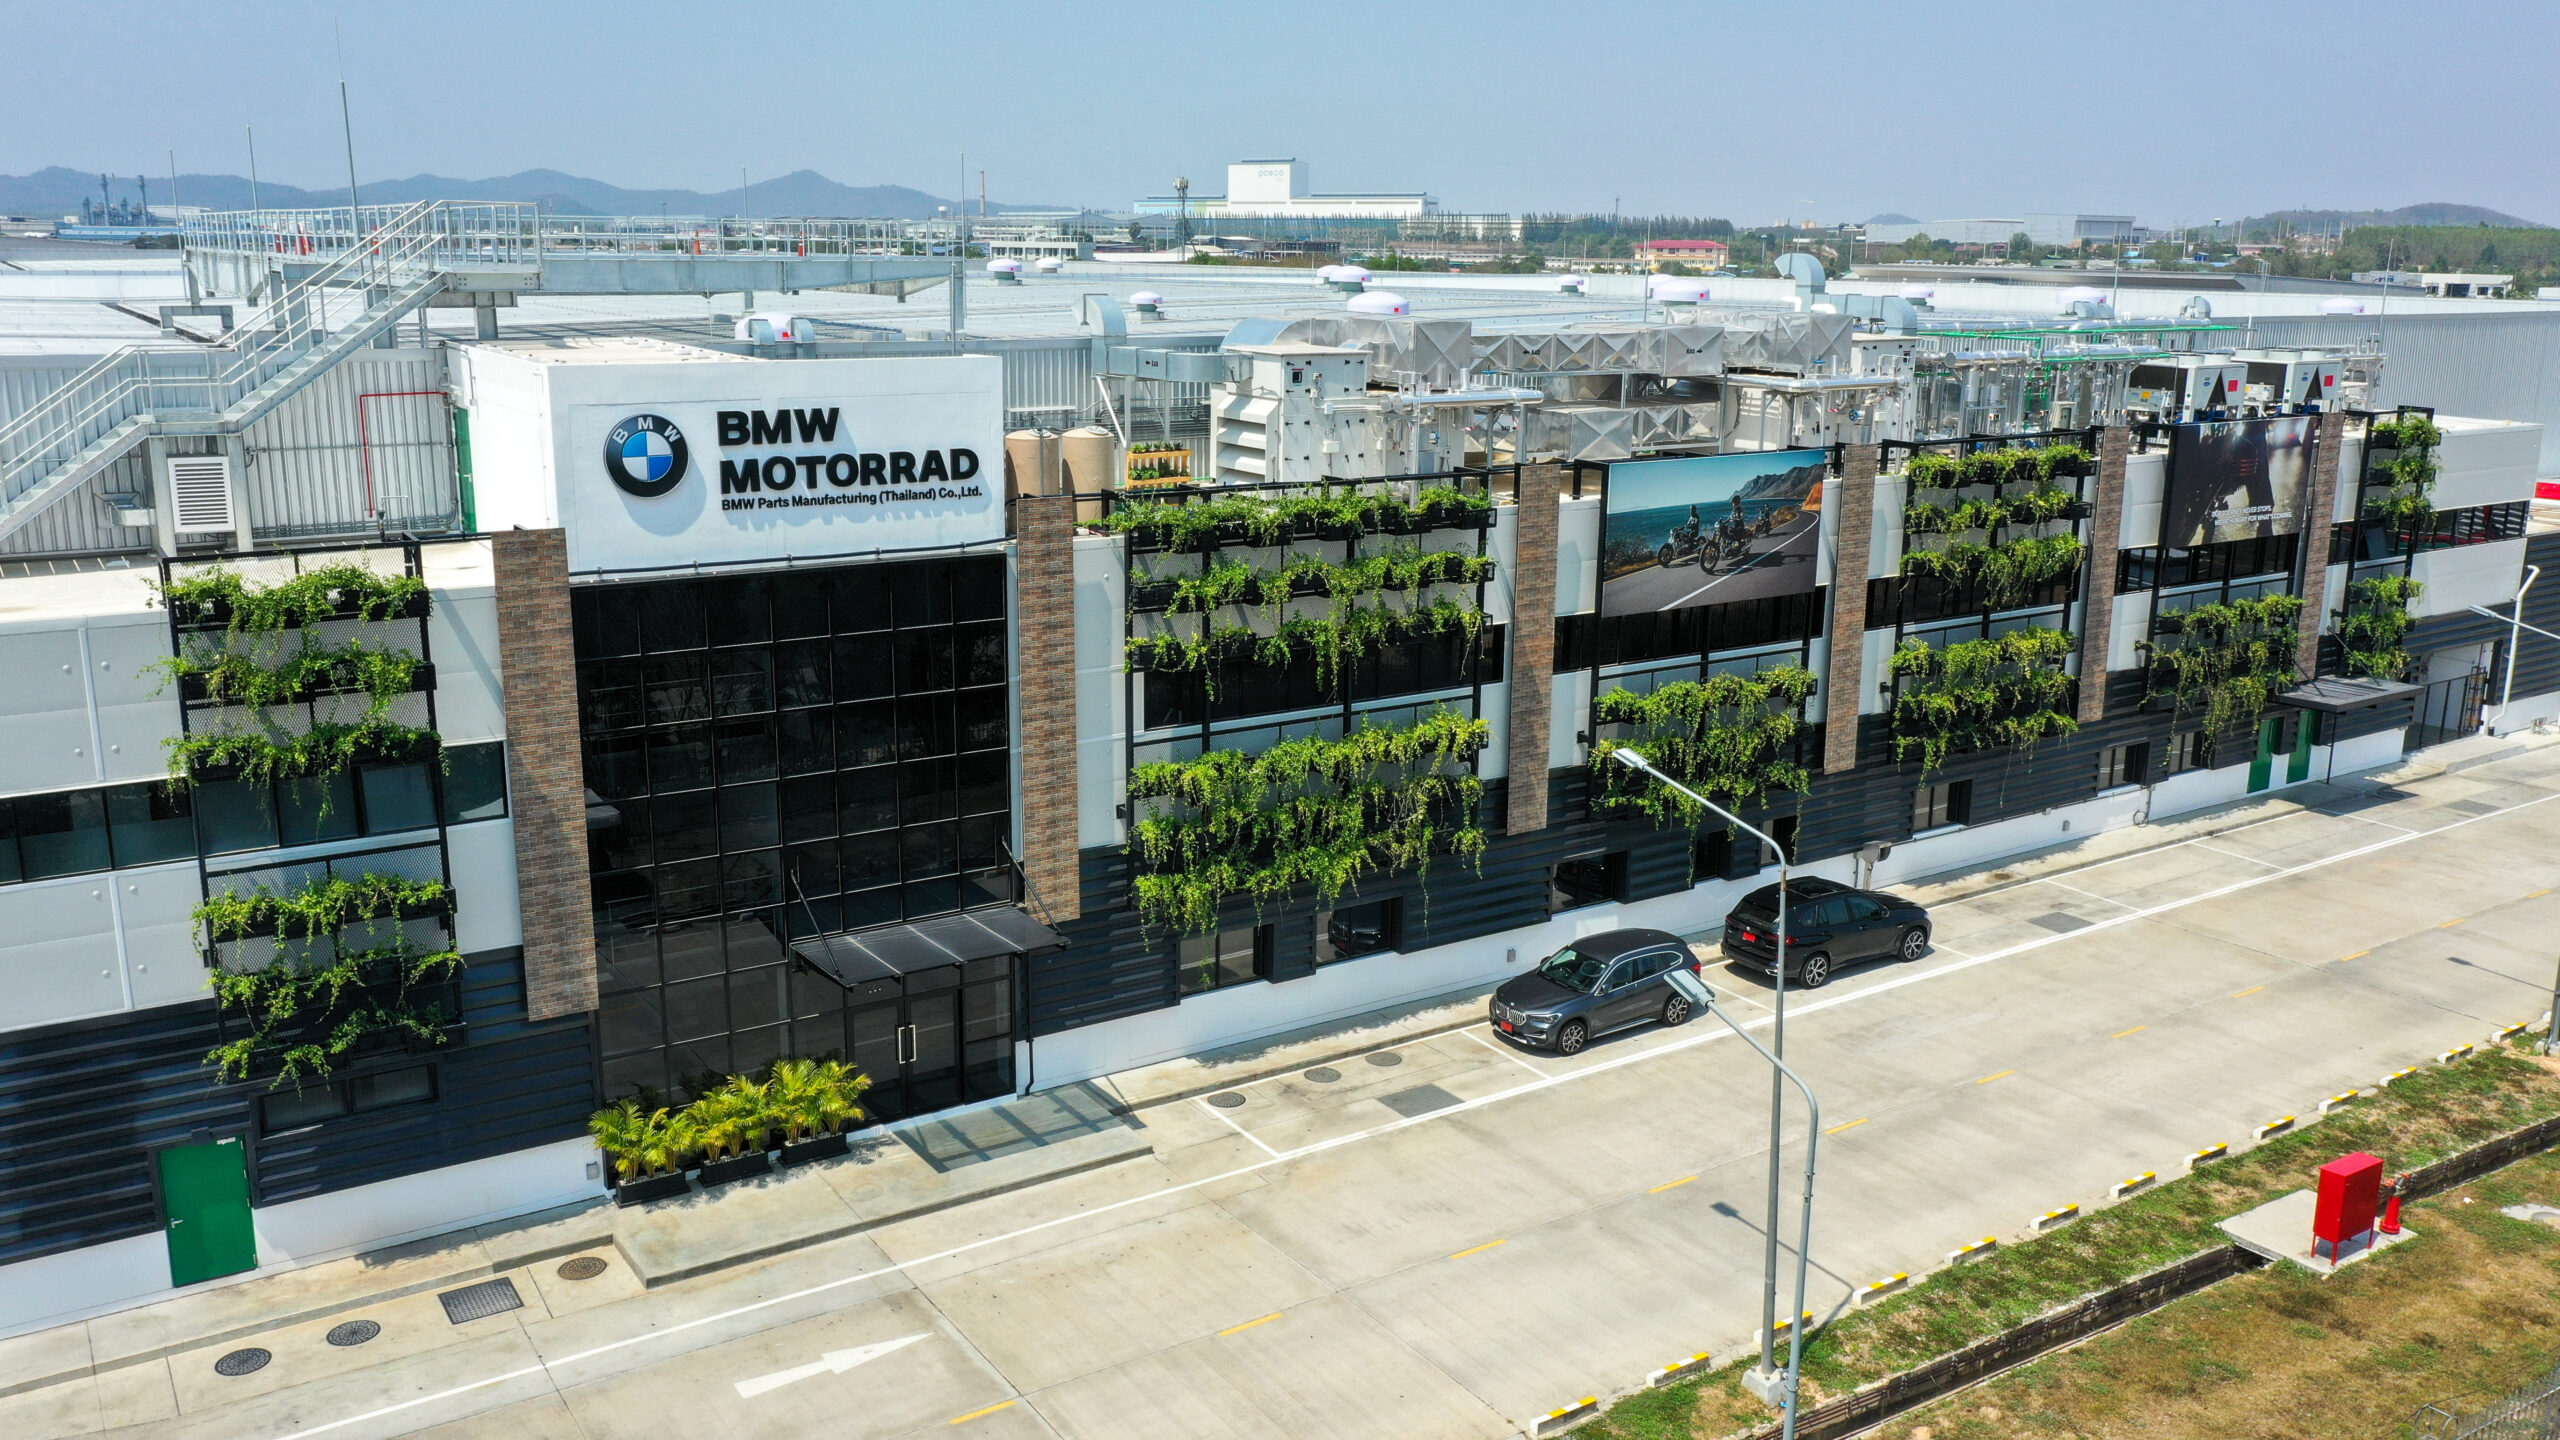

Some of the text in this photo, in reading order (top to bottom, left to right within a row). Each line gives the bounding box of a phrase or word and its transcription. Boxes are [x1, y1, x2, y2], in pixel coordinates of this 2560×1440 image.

[612, 416, 681, 445] BMW
[717, 407, 840, 446] BMW
[719, 448, 980, 495] MOTORRAD
[721, 486, 983, 511] BMW Parts Manufacturing (Thailand) Co.,Ltd.
